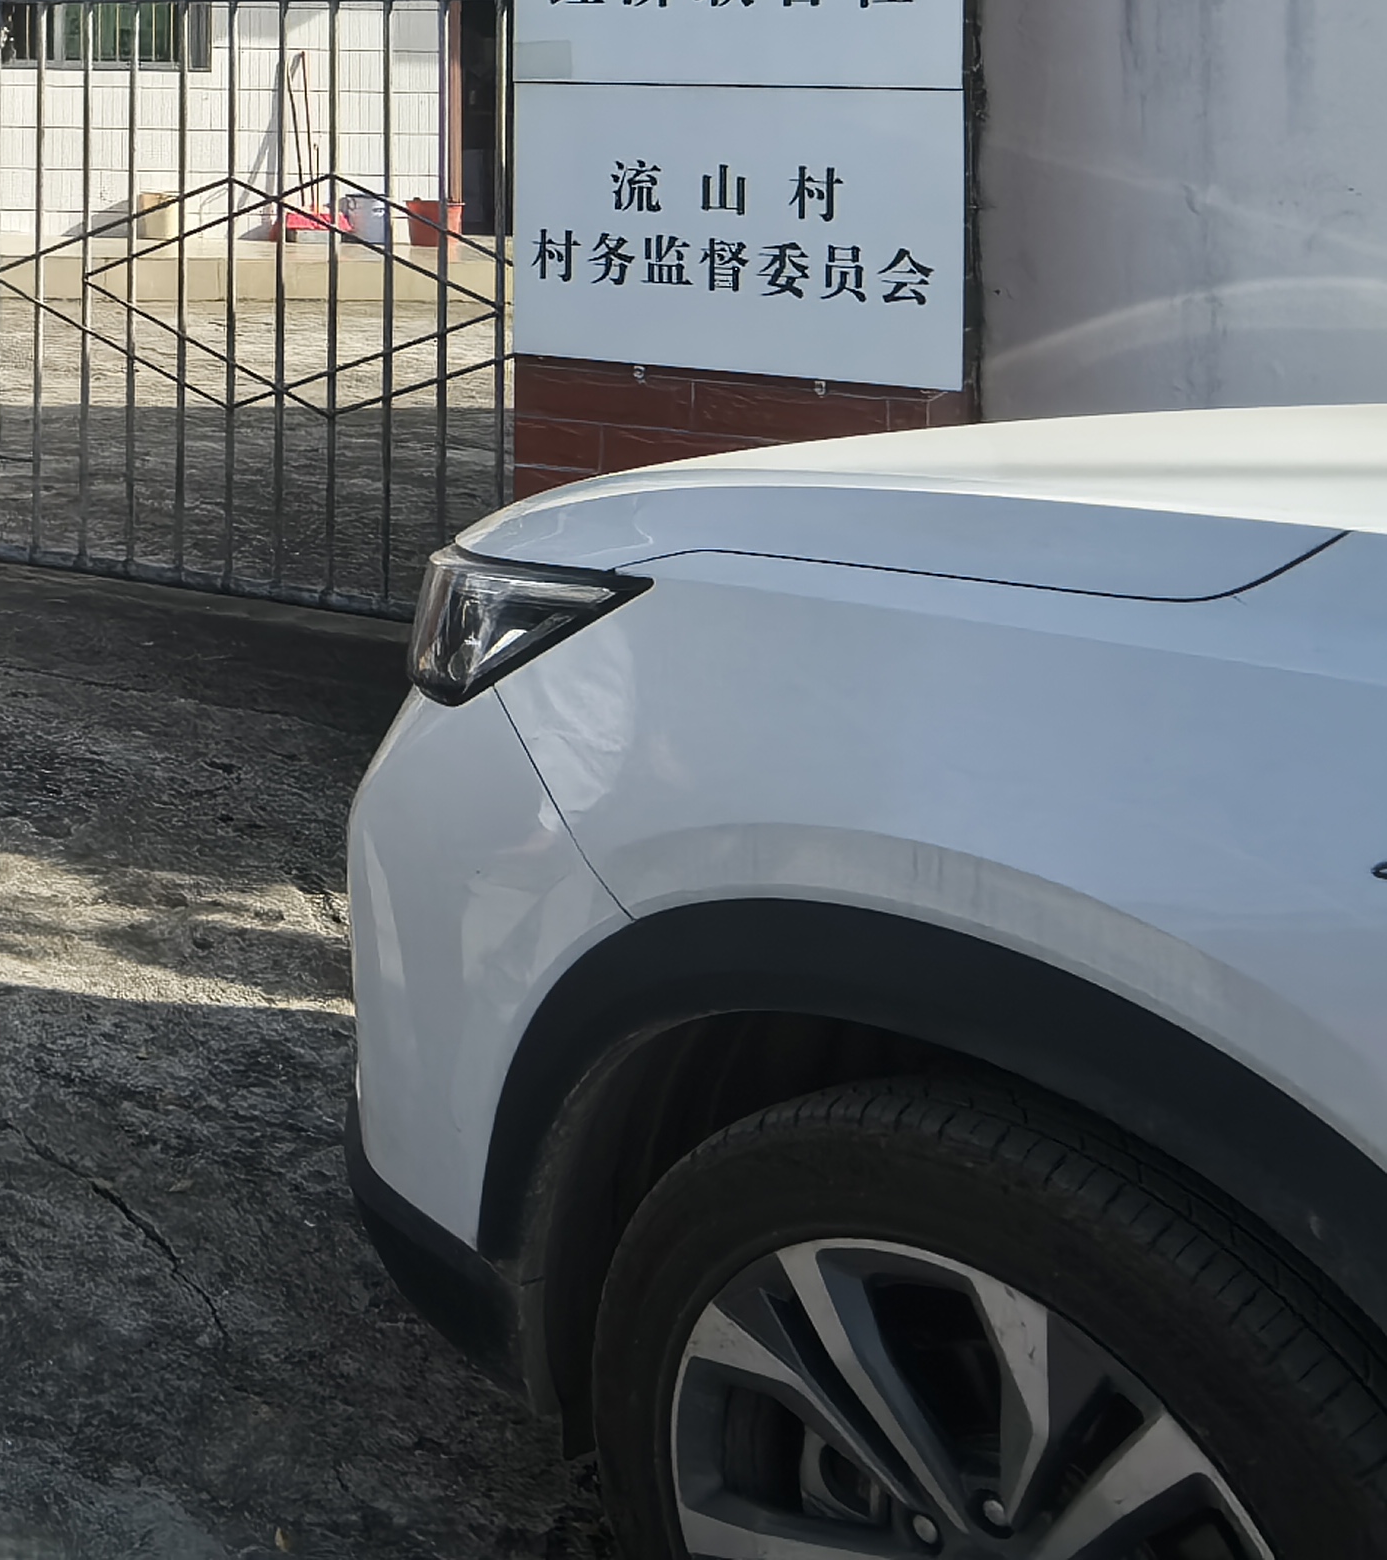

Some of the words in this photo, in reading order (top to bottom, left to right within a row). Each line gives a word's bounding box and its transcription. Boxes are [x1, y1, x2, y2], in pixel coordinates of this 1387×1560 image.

[610, 159, 844, 223] 流山村
[531, 228, 935, 306] 村务监督委员会
